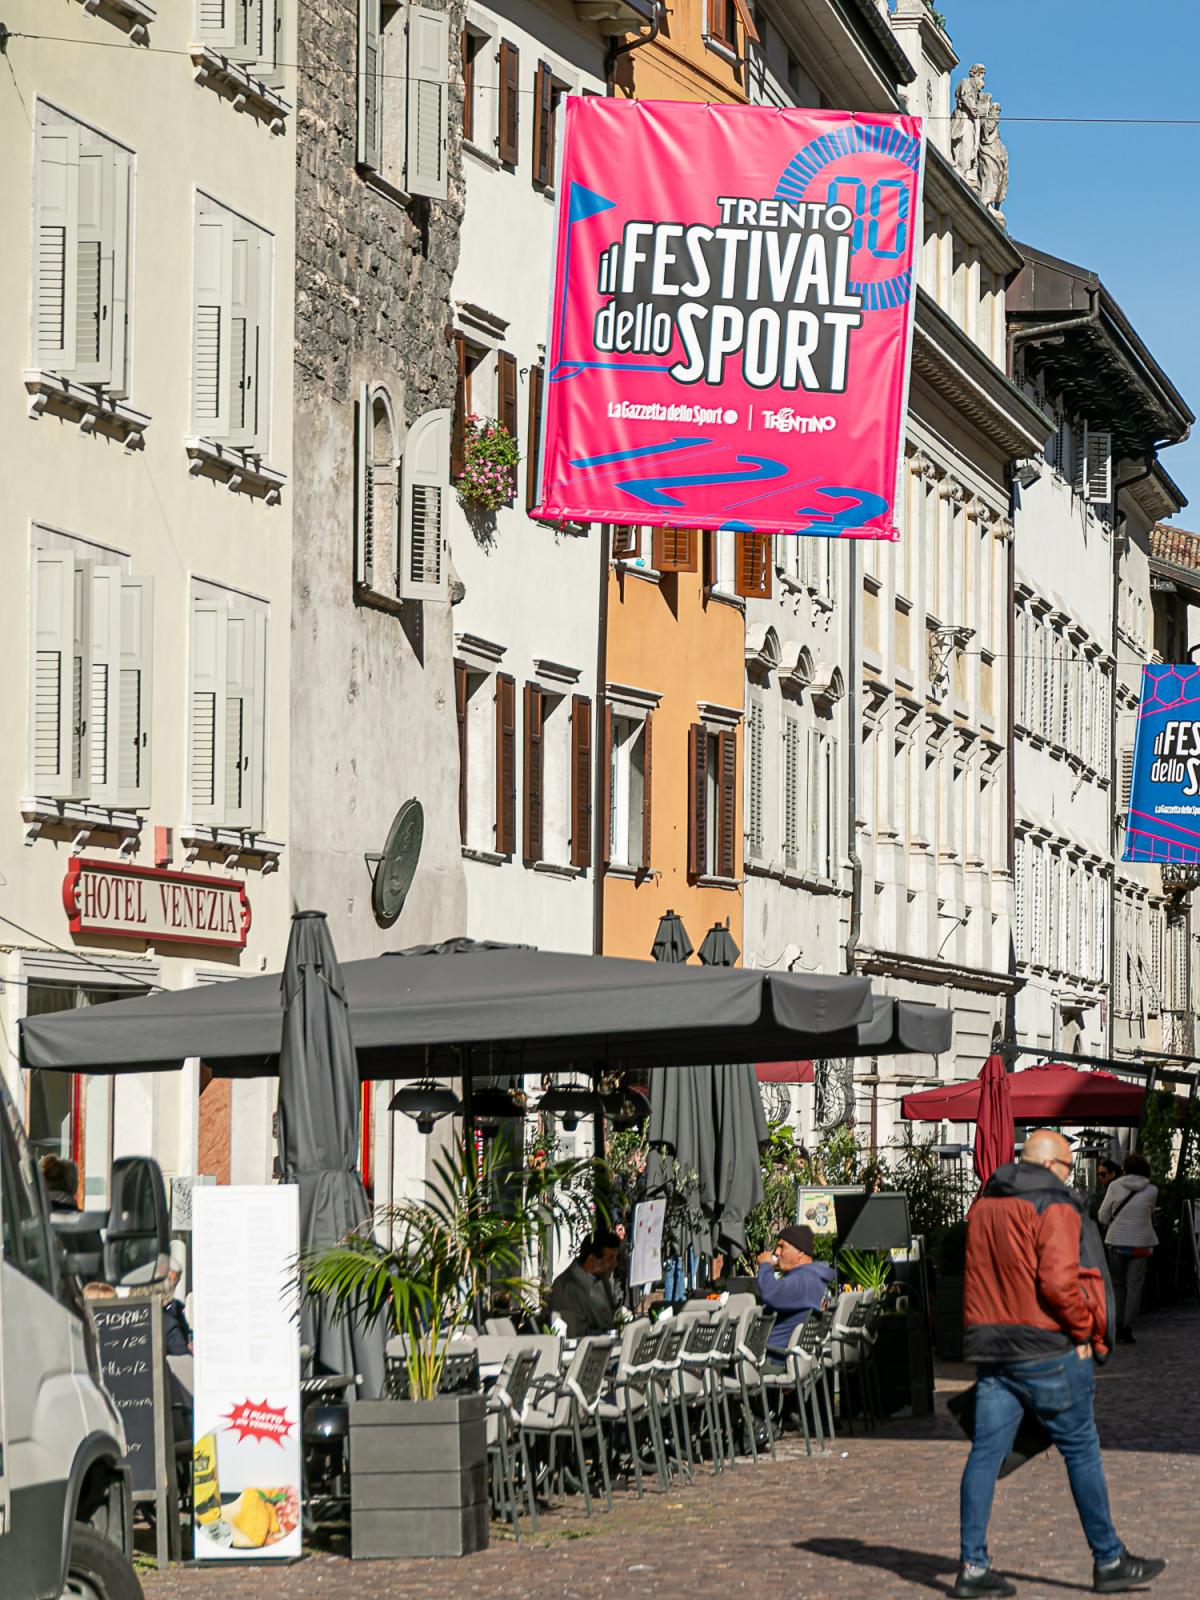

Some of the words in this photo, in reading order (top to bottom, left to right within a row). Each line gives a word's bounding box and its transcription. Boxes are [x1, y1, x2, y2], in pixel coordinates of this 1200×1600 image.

[718, 197, 853, 232] TRENTO
[599, 244, 620, 293] il
[622, 223, 863, 308] FESTIVAL
[594, 302, 672, 355] dello
[670, 305, 863, 394] SPORT
[692, 405, 722, 426] Sport
[762, 407, 836, 433] TRENTINO
[1153, 731, 1164, 755] il
[1151, 758, 1185, 783] dello
[84, 874, 147, 923] HOTEL
[160, 884, 237, 933] VENEZIA
